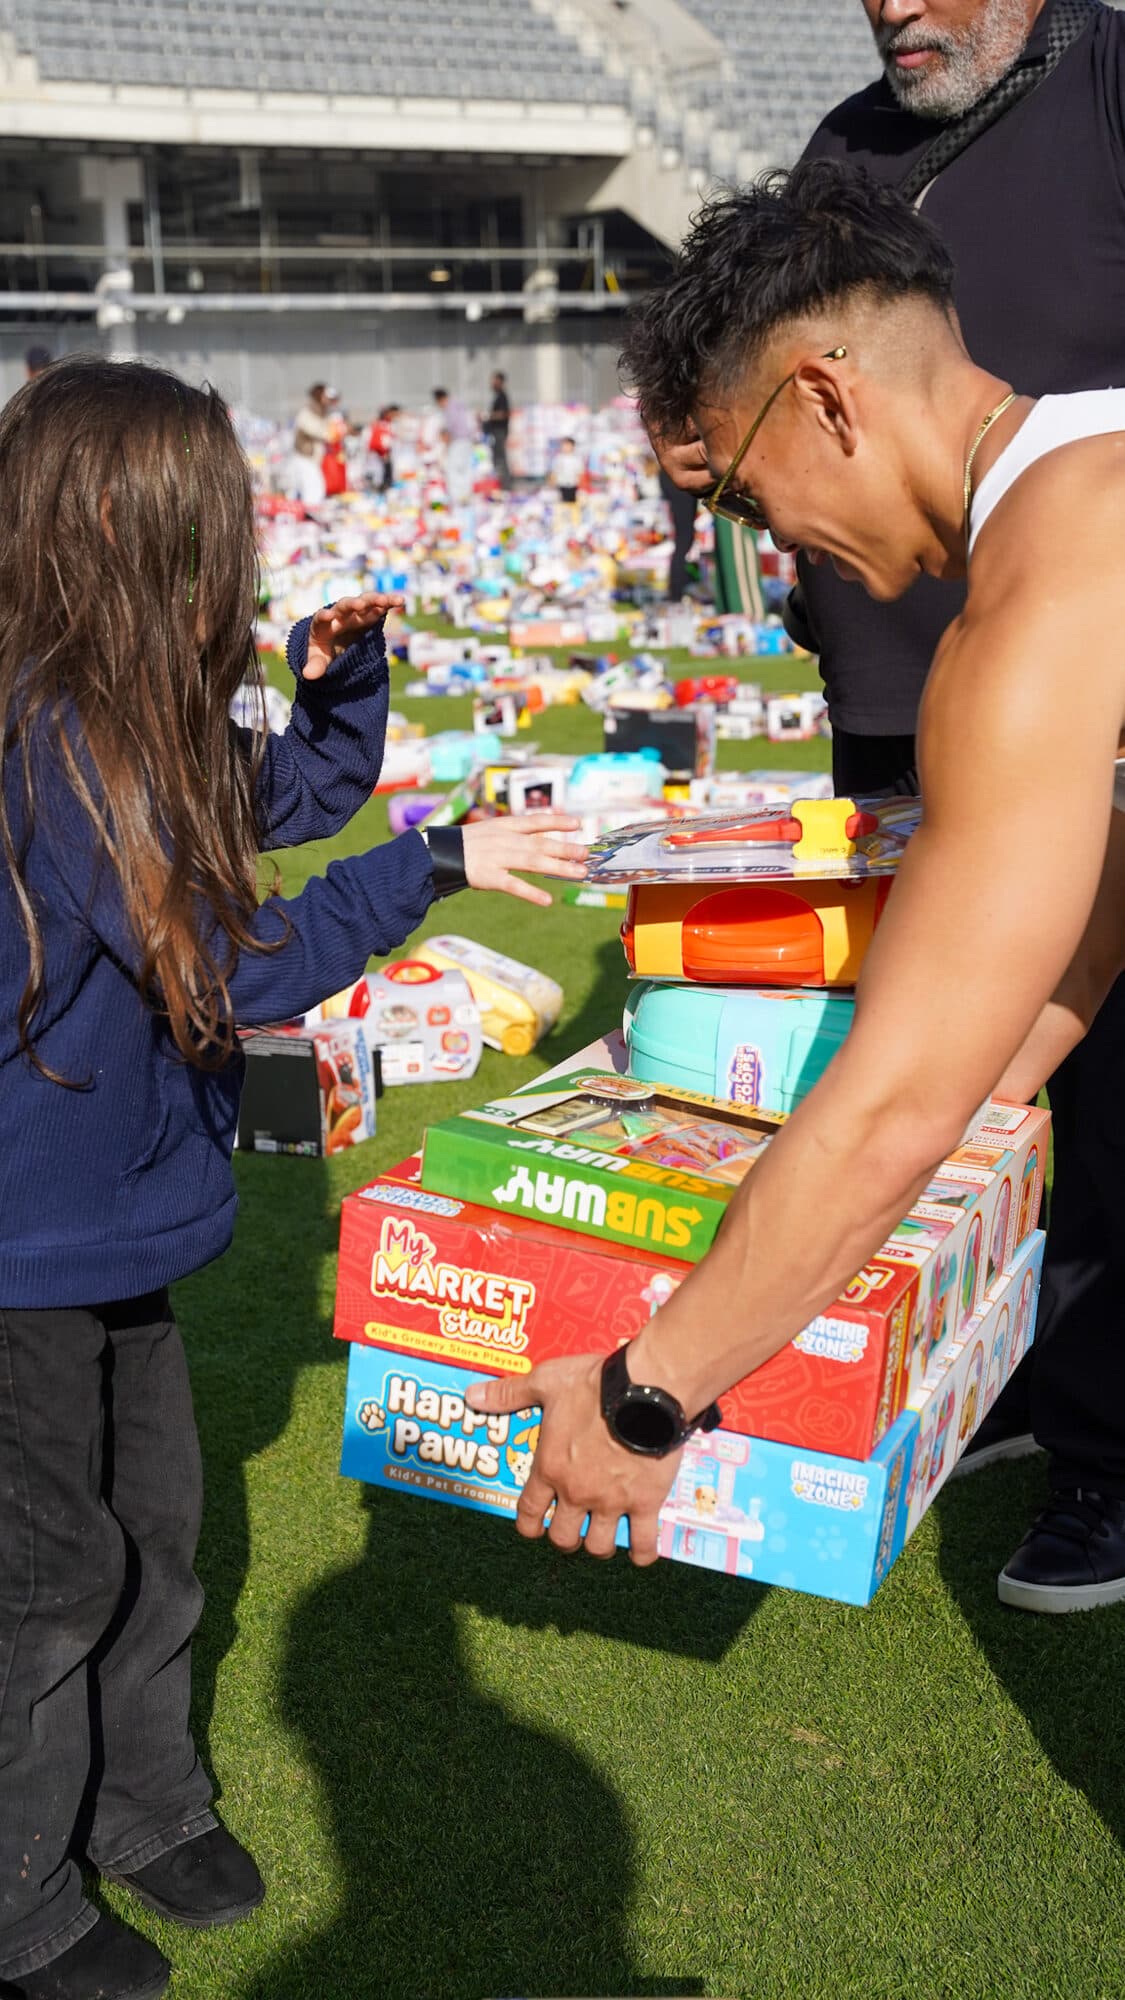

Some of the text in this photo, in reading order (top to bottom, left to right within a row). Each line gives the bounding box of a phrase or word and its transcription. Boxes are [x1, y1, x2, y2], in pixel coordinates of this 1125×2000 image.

[741, 1052, 755, 1105] COOPS
[507, 1138, 726, 1194] SUBWAY
[492, 1166, 703, 1247] SUBWAY
[385, 1220, 431, 1266] My
[374, 1257, 532, 1317] MARKET
[370, 1326, 526, 1370] Kid's Grocery Store Playset
[444, 1307, 523, 1348] stand
[806, 1337, 851, 1360] ZONE
[386, 1375, 511, 1446] Happy
[393, 1417, 500, 1478] Paws
[389, 1467, 422, 1484] Kid's
[426, 1477, 449, 1491] Pet
[793, 1462, 868, 1495] IMAGINE
[805, 1485, 851, 1507] ZONE
